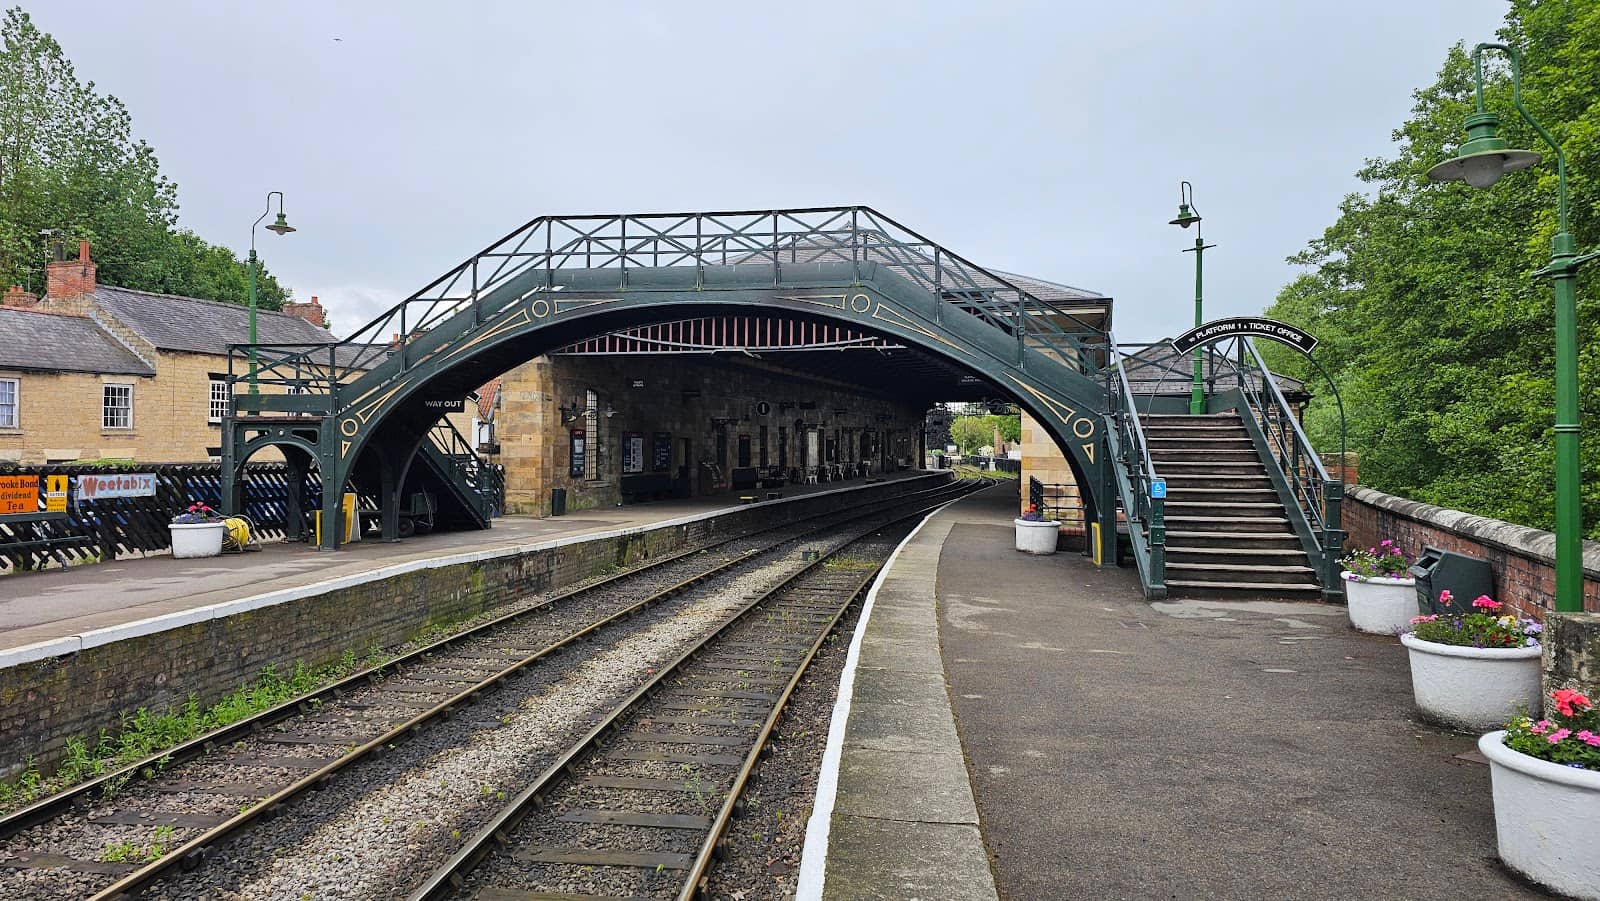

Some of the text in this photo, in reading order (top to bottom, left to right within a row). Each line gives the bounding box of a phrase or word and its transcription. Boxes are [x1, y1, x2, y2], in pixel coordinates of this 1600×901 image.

[1195, 323, 1236, 339] PLATFORM
[1249, 322, 1277, 332] TICKET
[1277, 327, 1303, 343] OFFICE
[425, 400, 462, 408] WAY OUT
[19, 479, 39, 488] Bond
[82, 476, 151, 497] Weetabix
[1, 491, 32, 500] dividend
[7, 500, 24, 511] Tea
